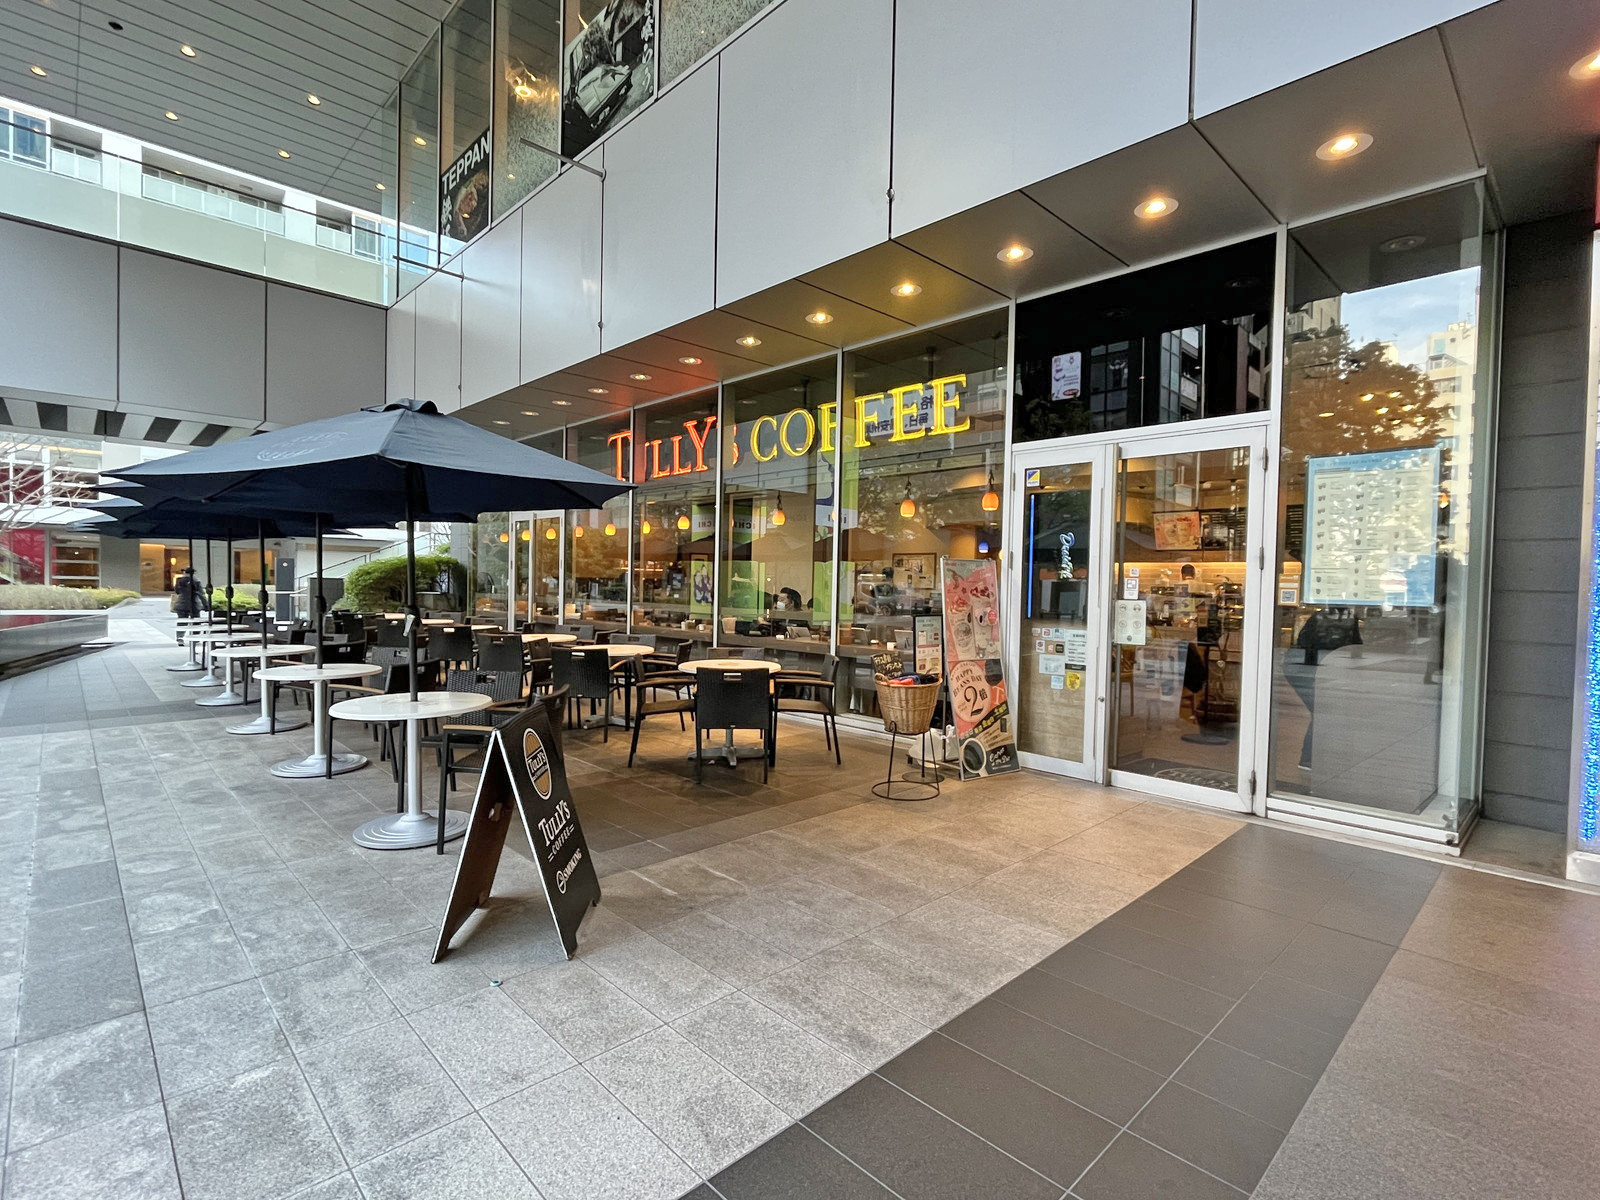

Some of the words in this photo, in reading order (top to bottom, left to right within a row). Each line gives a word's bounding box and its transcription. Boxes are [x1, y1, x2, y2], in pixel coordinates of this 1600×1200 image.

[442, 130, 490, 195] TEPPAN
[750, 373, 971, 463] COFFEE
[551, 825, 571, 855] COFFEE
[563, 848, 582, 881] SMOKING
